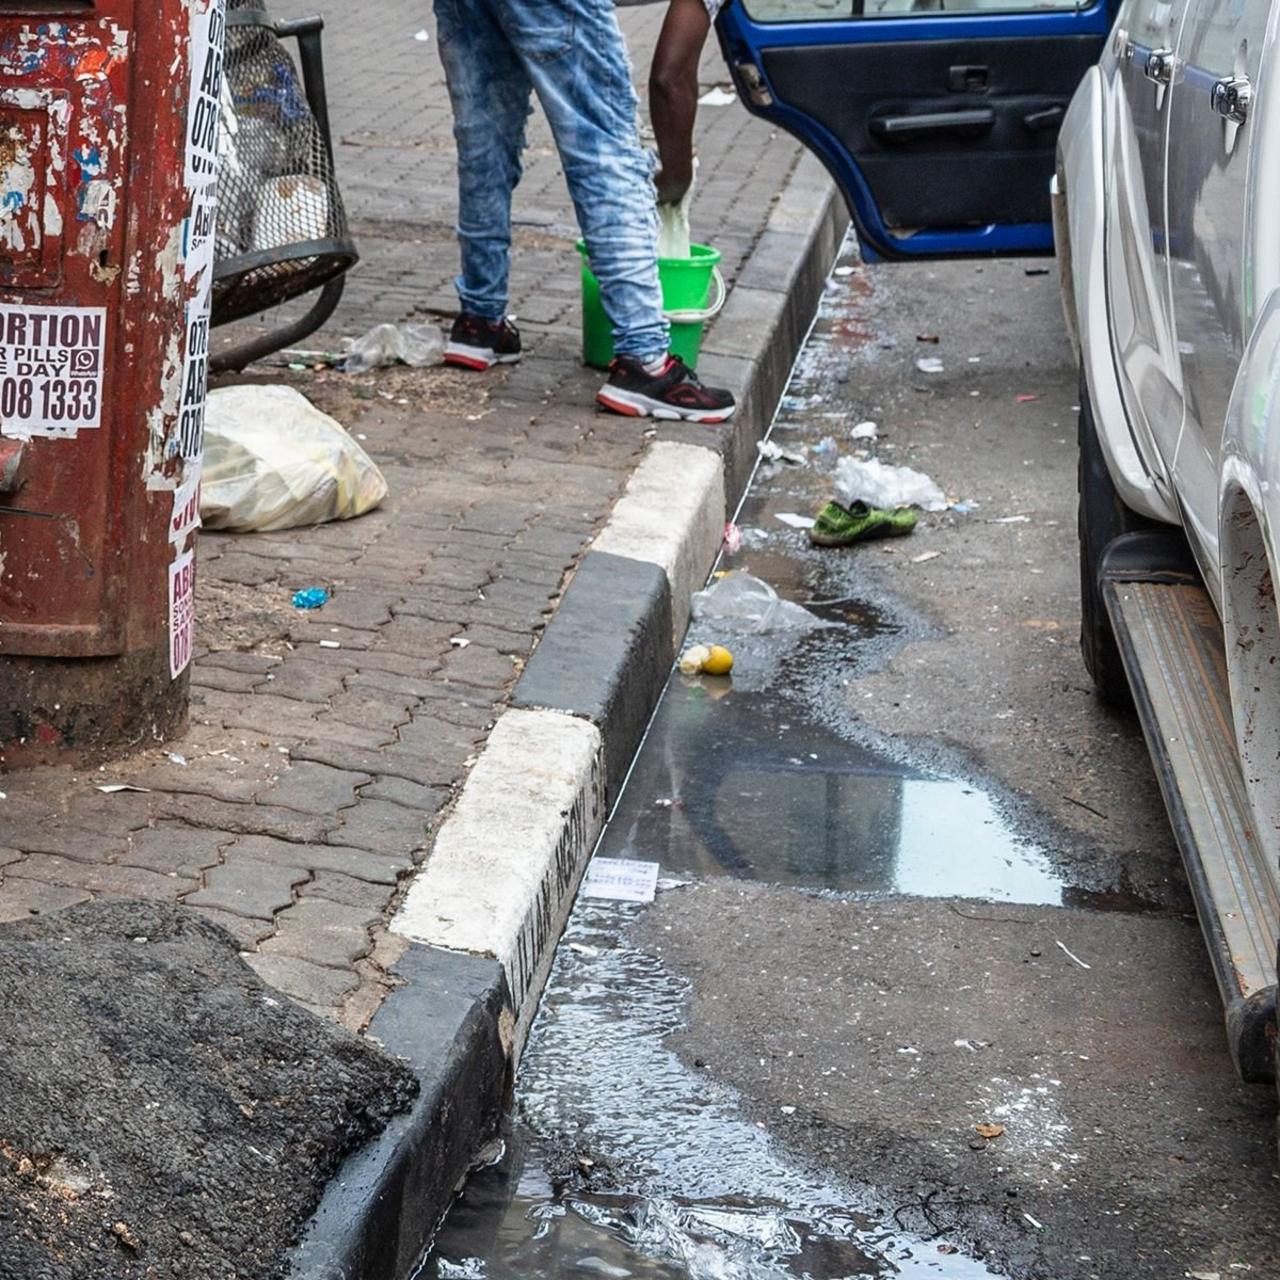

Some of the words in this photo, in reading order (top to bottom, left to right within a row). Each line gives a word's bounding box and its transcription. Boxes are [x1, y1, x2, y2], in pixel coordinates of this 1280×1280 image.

[14, 347, 70, 363] PILLS
[17, 363, 67, 377] DAY
[40, 379, 98, 421] 1333
